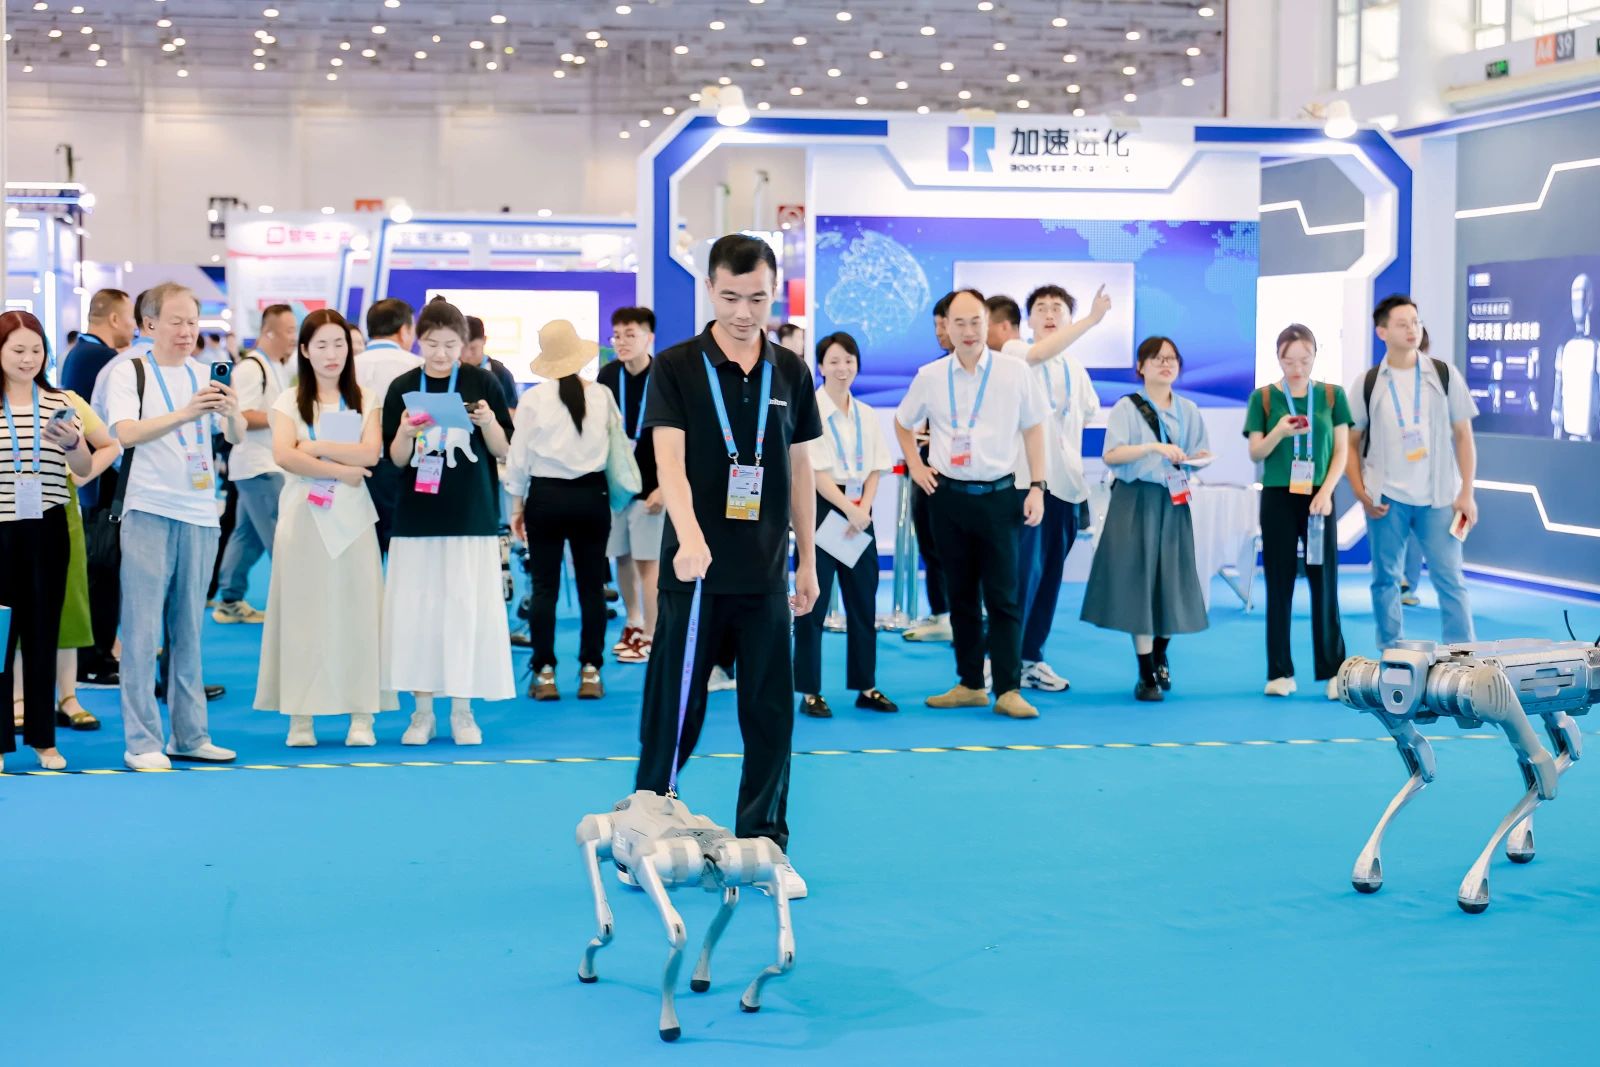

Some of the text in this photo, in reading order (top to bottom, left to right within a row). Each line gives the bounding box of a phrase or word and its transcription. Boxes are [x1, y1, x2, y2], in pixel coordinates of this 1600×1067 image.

[1556, 32, 1573, 58] 39
[1010, 127, 1130, 157] 加速进化
